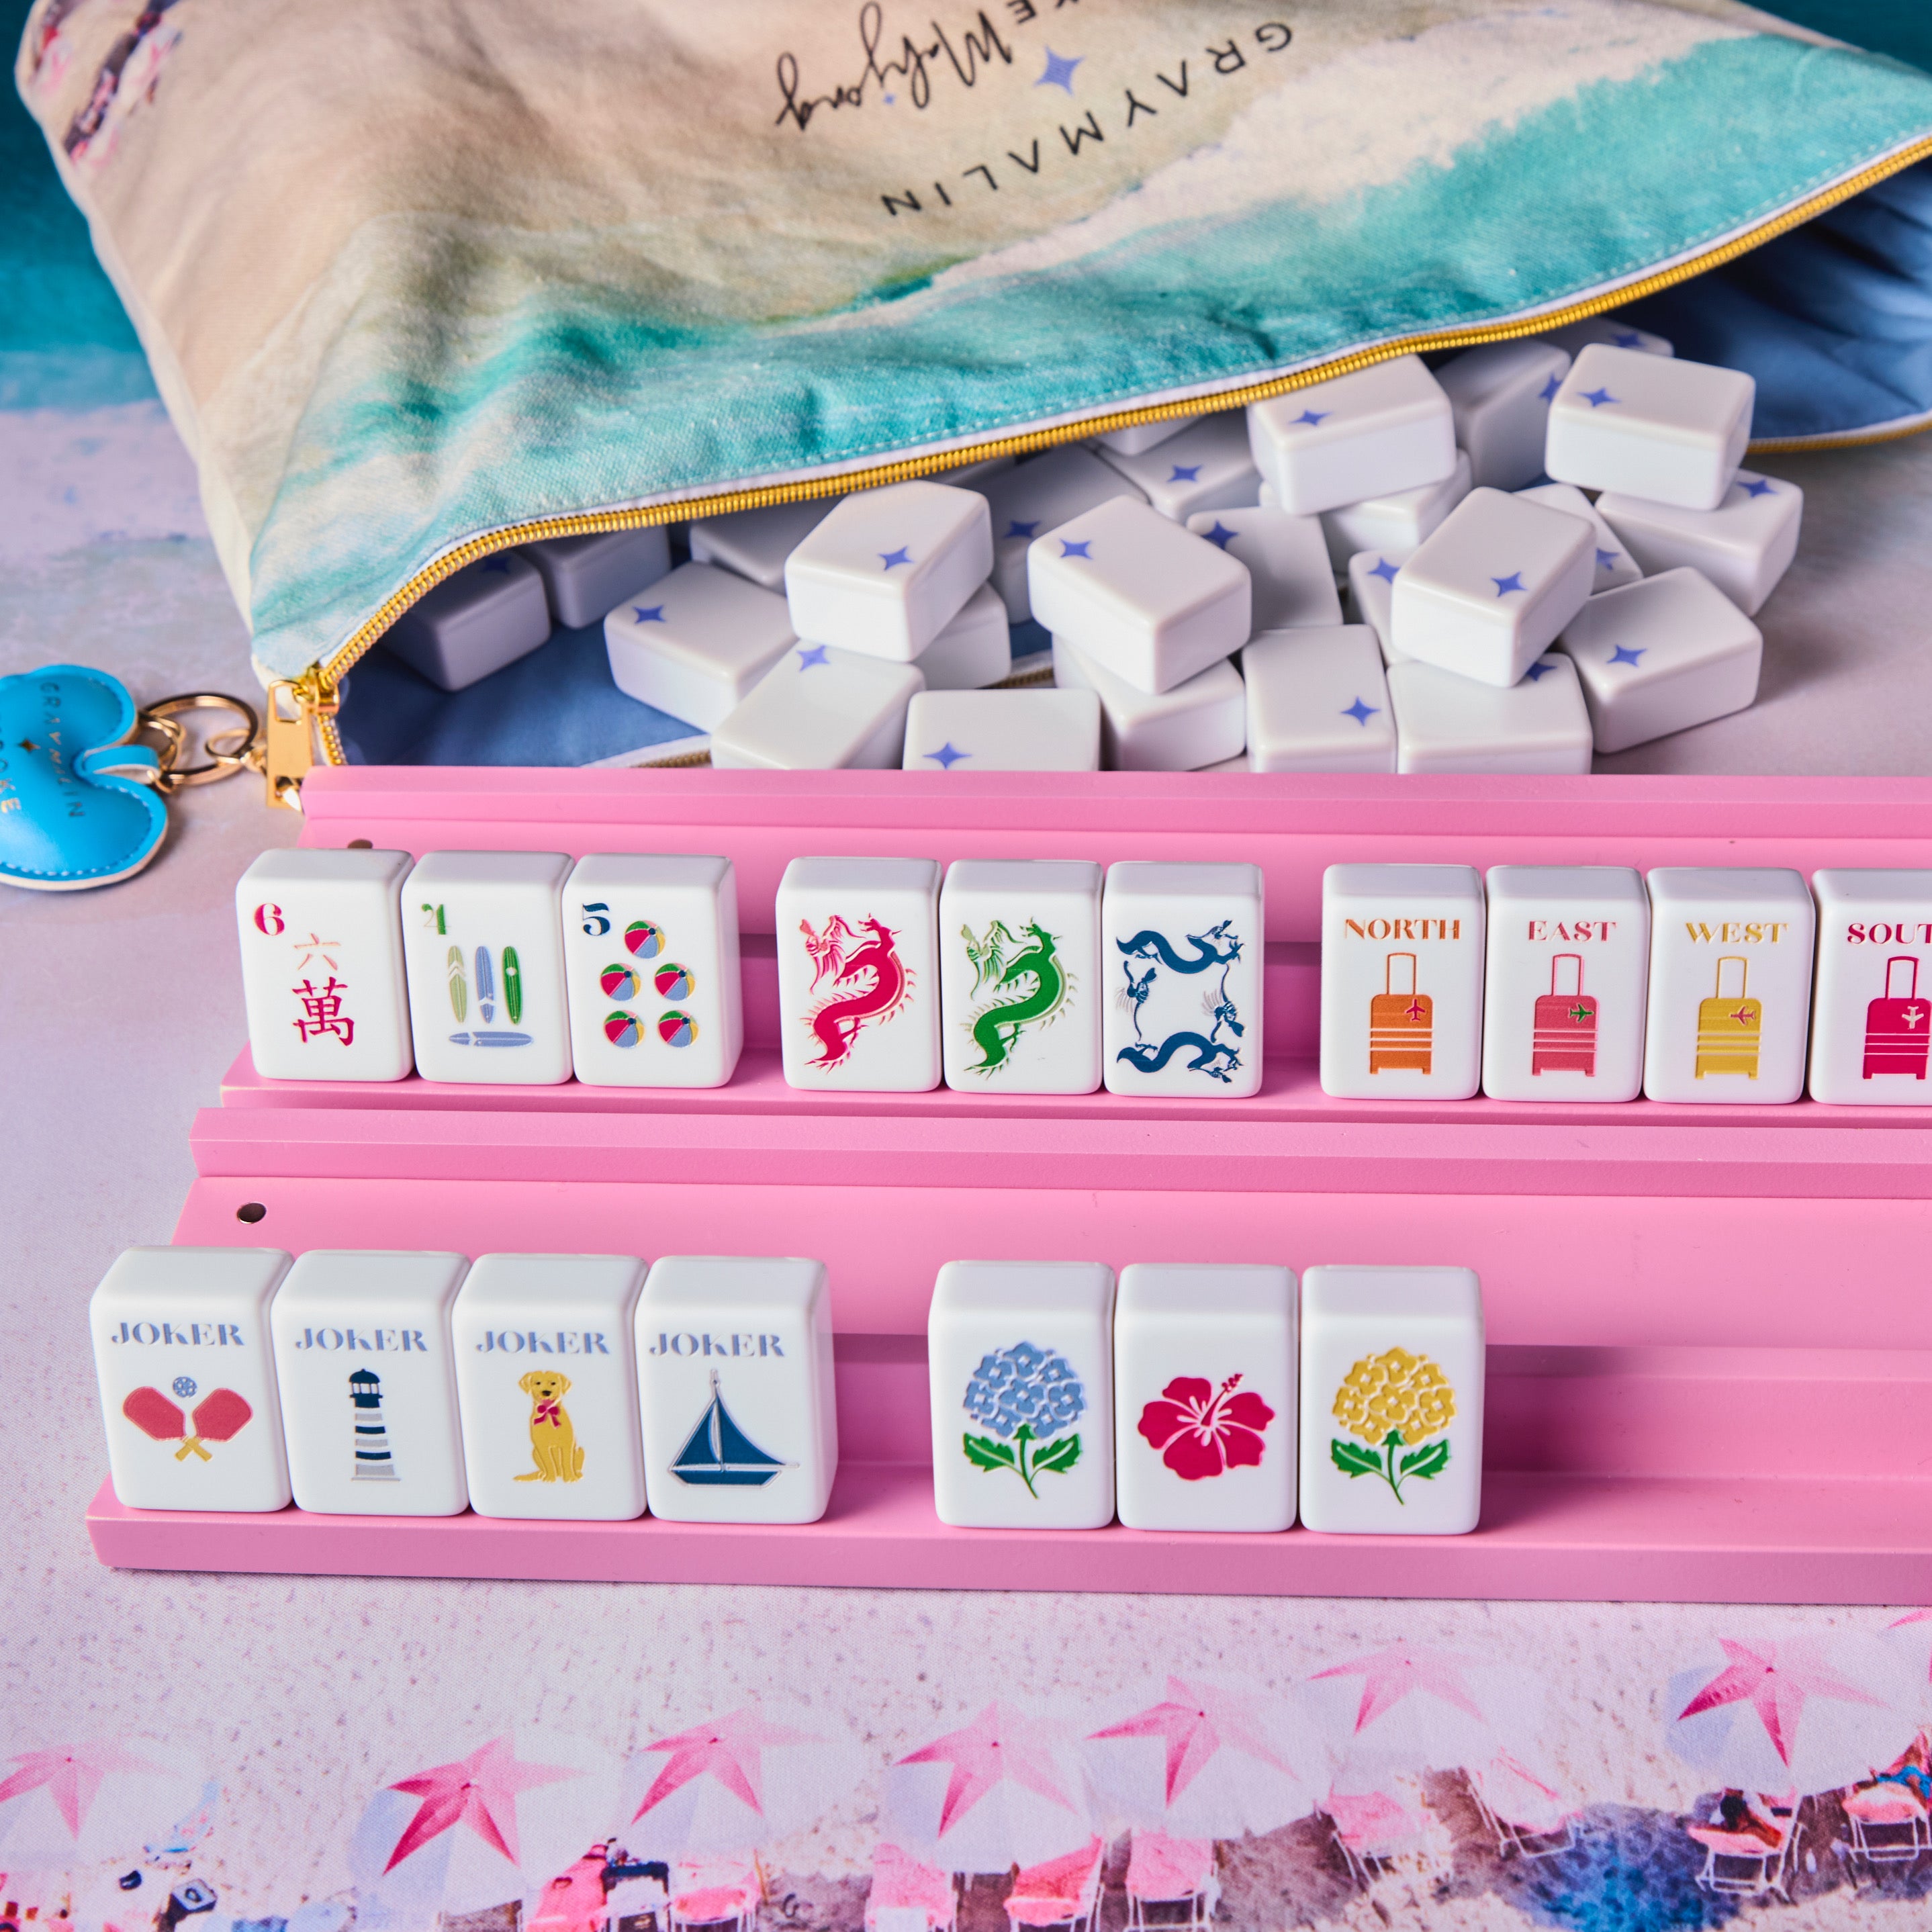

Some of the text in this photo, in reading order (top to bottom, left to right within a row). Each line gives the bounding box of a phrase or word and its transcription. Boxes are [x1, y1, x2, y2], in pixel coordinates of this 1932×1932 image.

[252, 903, 285, 936] 6
[420, 903, 451, 935] 4
[582, 903, 612, 937] 5
[1344, 918, 1461, 940] NORTH
[1528, 920, 1617, 942] EAST
[1685, 922, 1789, 944] WEST
[1847, 923, 1932, 945] SOUT
[111, 1322, 246, 1346] JOKER
[295, 1328, 428, 1352] JOKER
[475, 1330, 610, 1355] JOKER
[649, 1333, 785, 1357] JOKER
